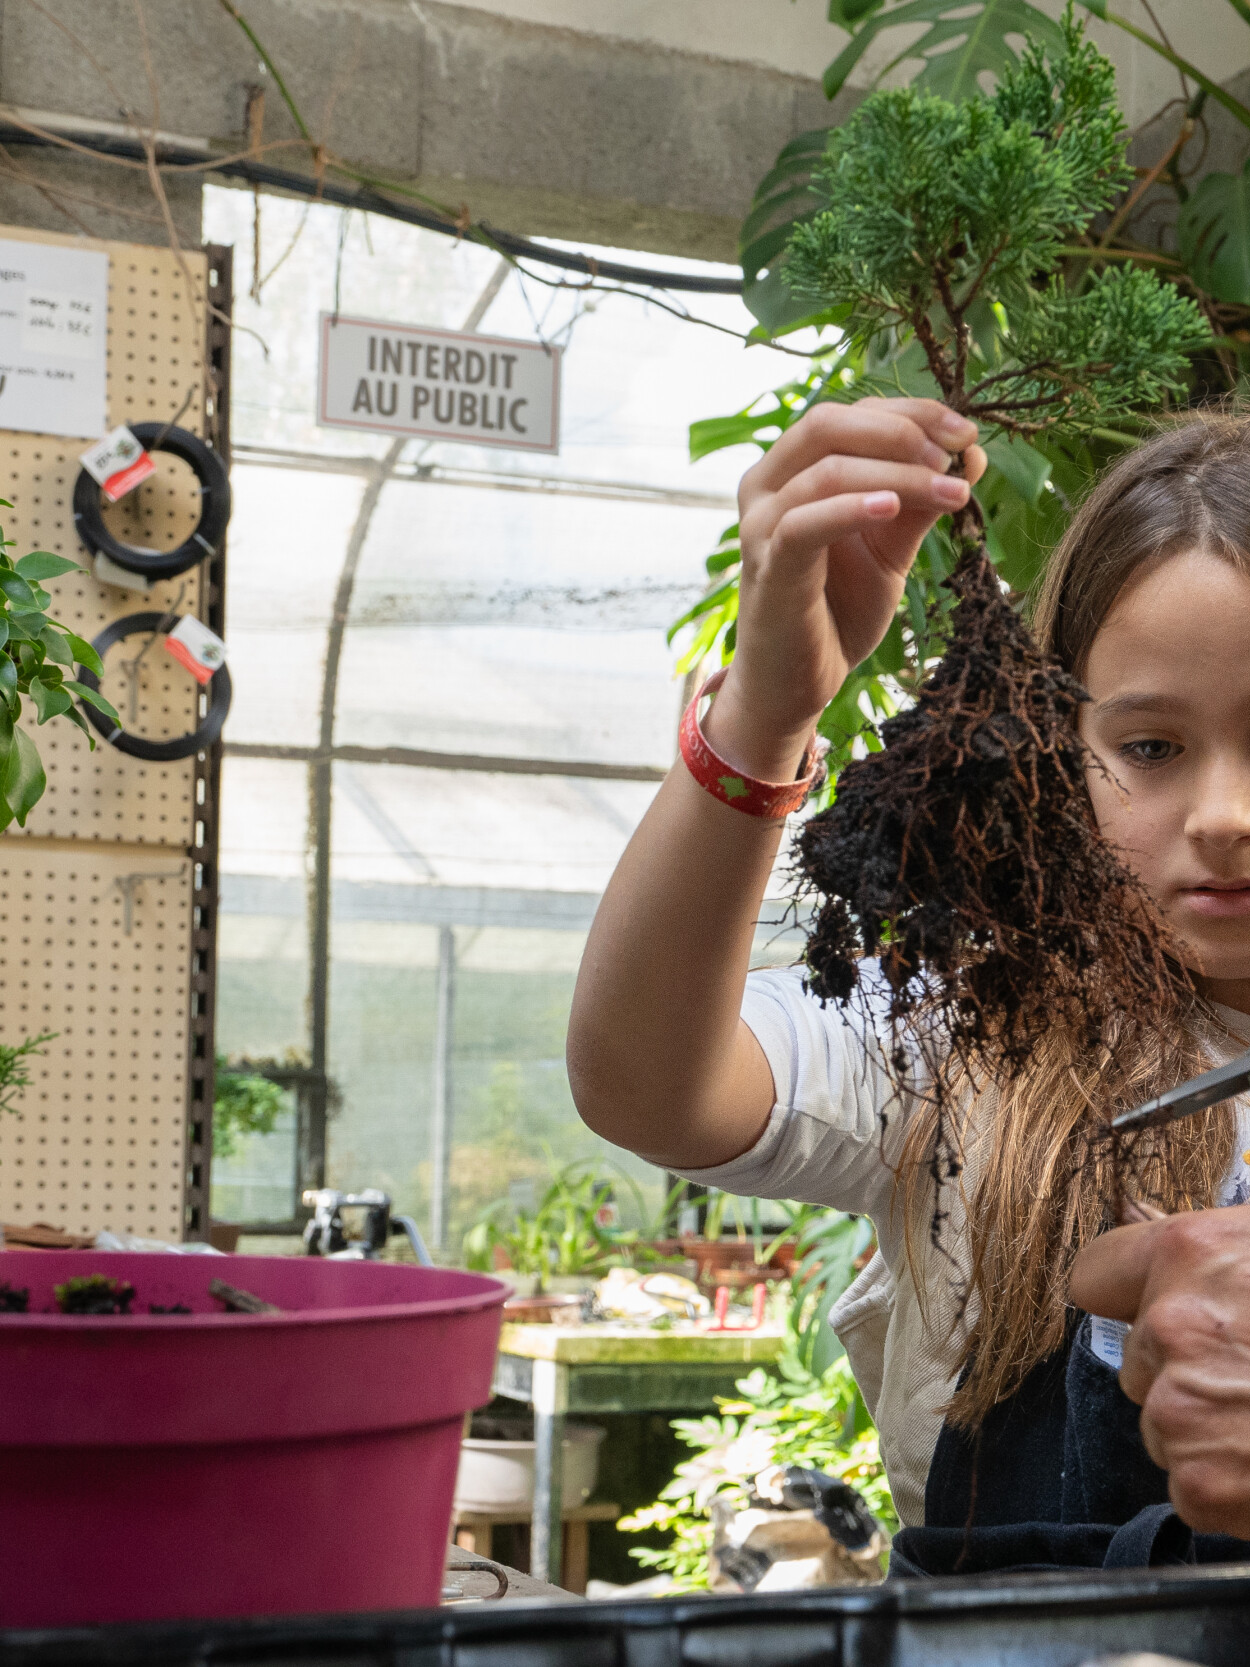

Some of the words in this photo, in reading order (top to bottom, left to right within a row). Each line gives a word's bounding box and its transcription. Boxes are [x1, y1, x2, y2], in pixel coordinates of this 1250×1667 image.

[368, 336, 517, 389] INTERDIT
[352, 378, 398, 417] AU
[411, 385, 528, 434] PUBLIC
